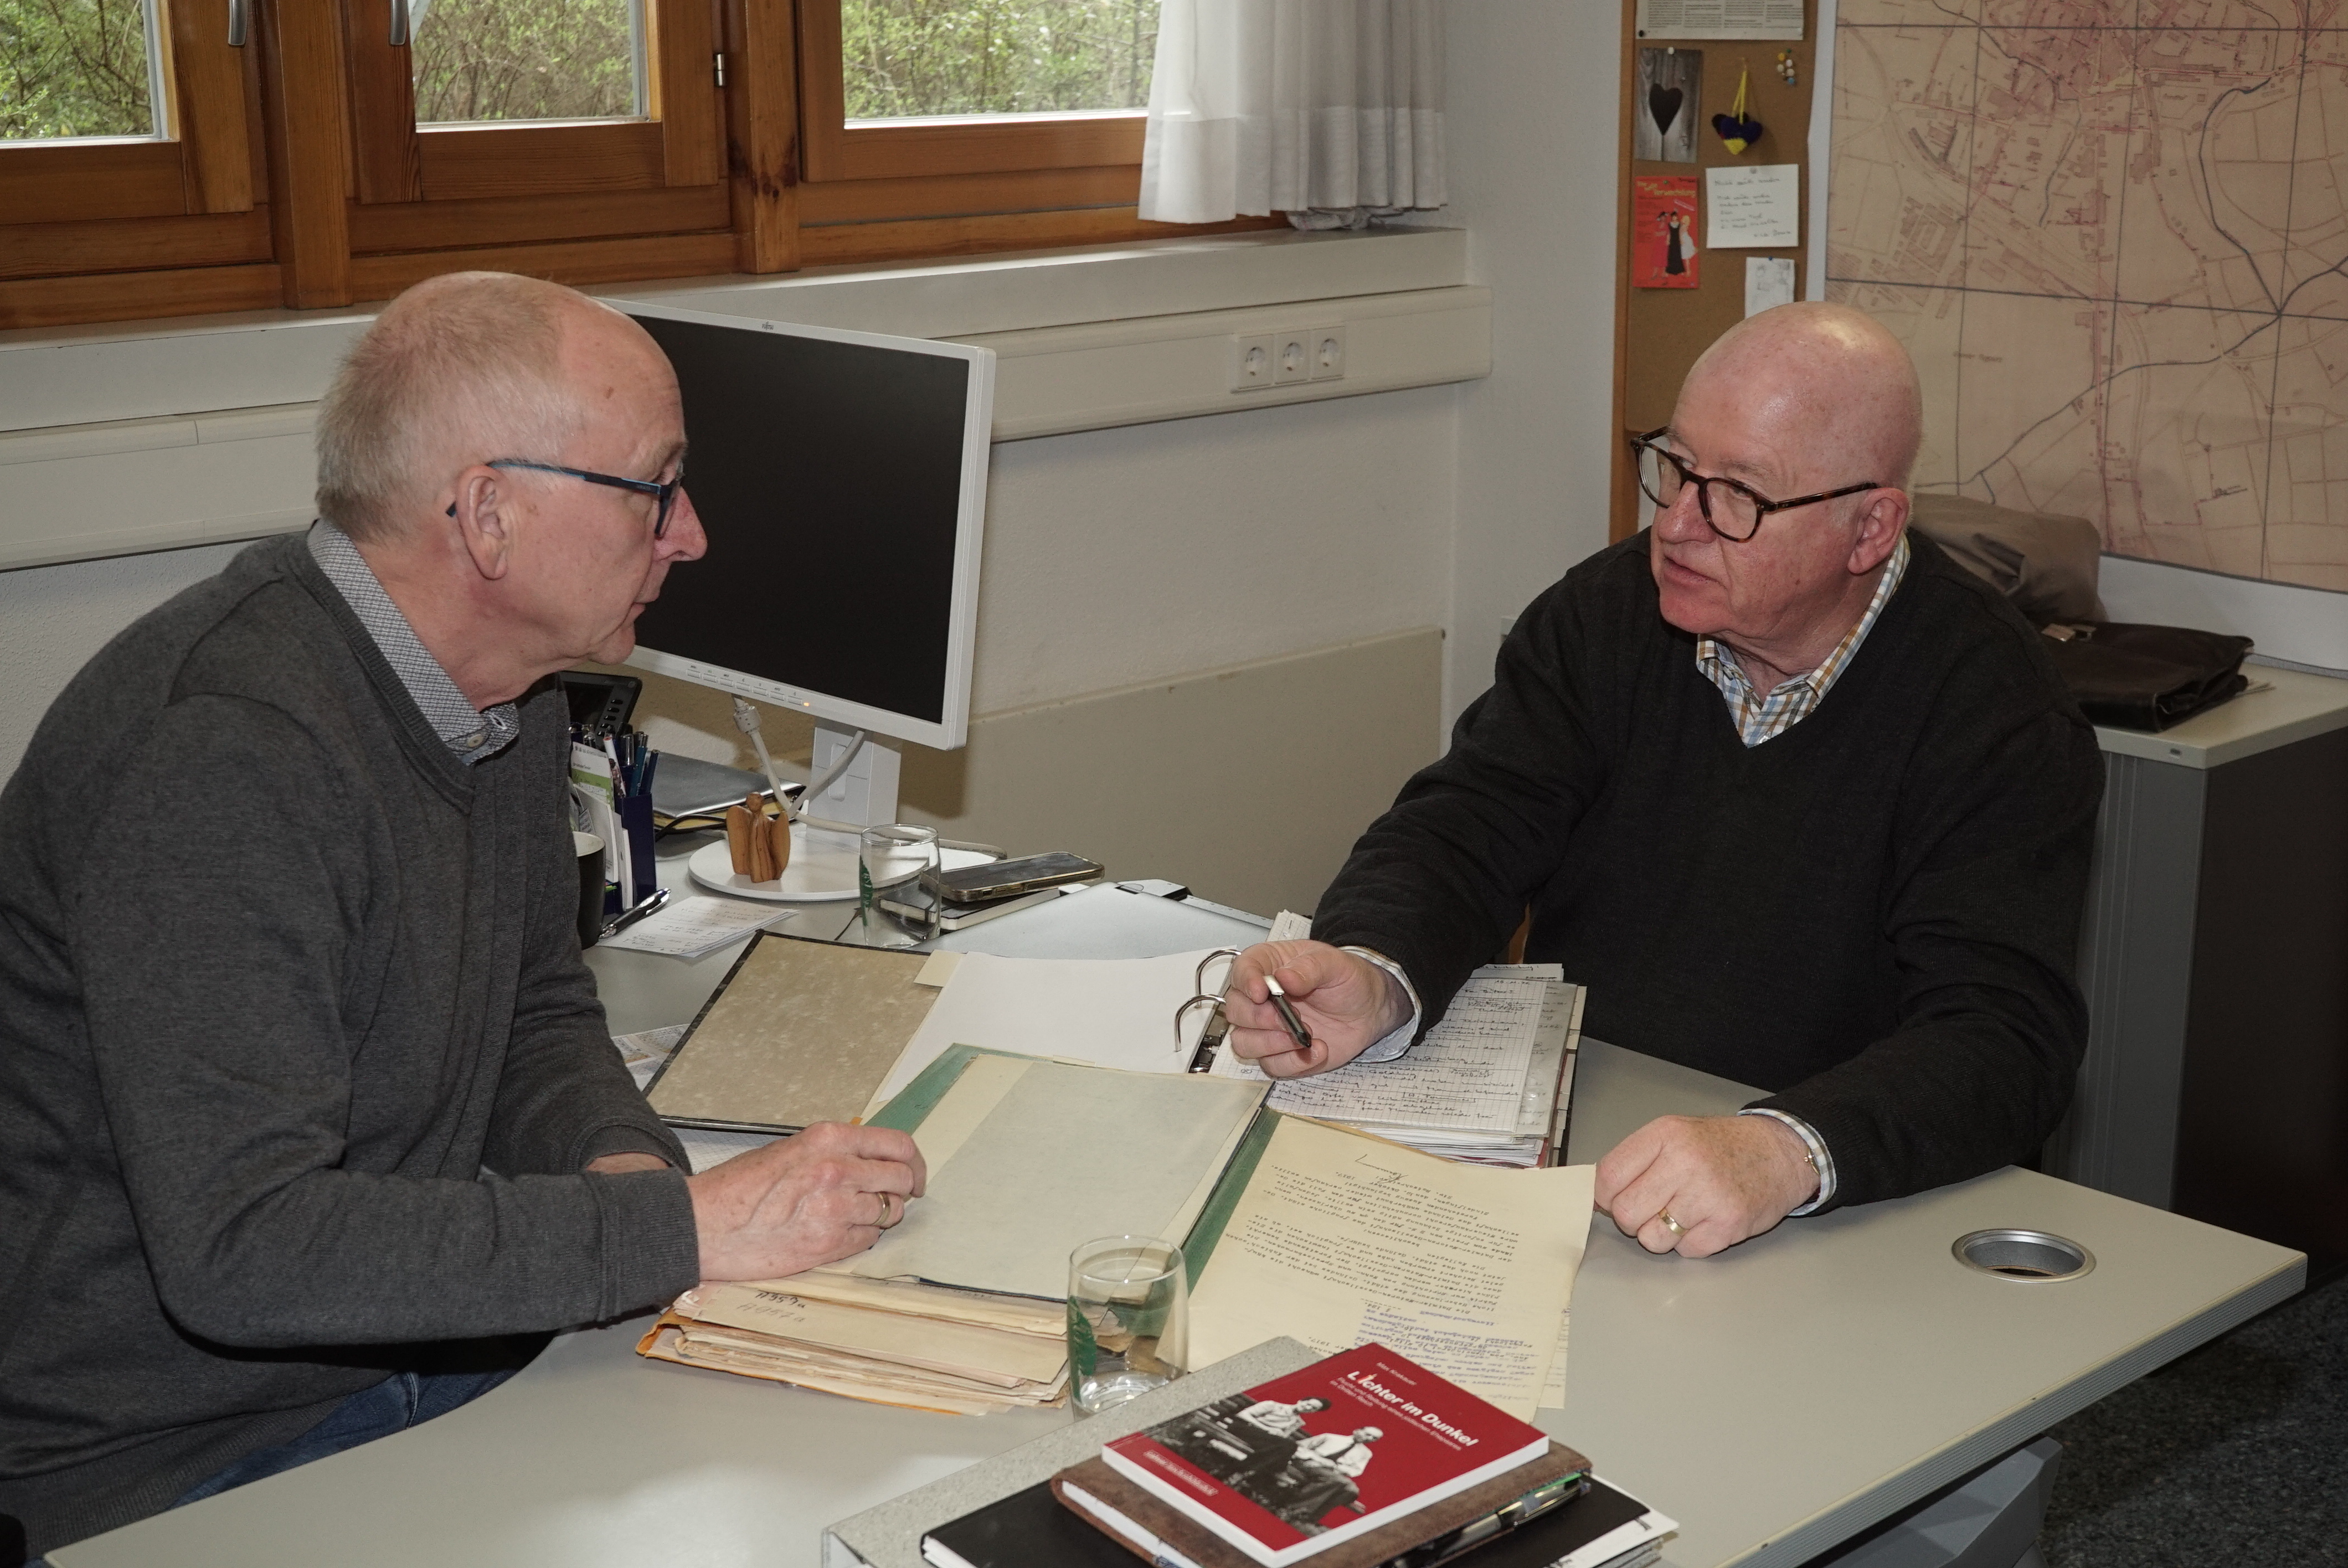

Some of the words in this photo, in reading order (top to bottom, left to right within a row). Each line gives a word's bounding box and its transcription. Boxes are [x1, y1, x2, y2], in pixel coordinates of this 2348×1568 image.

[1376, 1362, 1390, 1371] Max
[1353, 1386, 1367, 1396] und
[1356, 1396, 1373, 1407] Reich
[1347, 1371, 1404, 1404] Lichter
[1400, 1401, 1423, 1416] im
[1421, 1413, 1479, 1446] Dunkel
